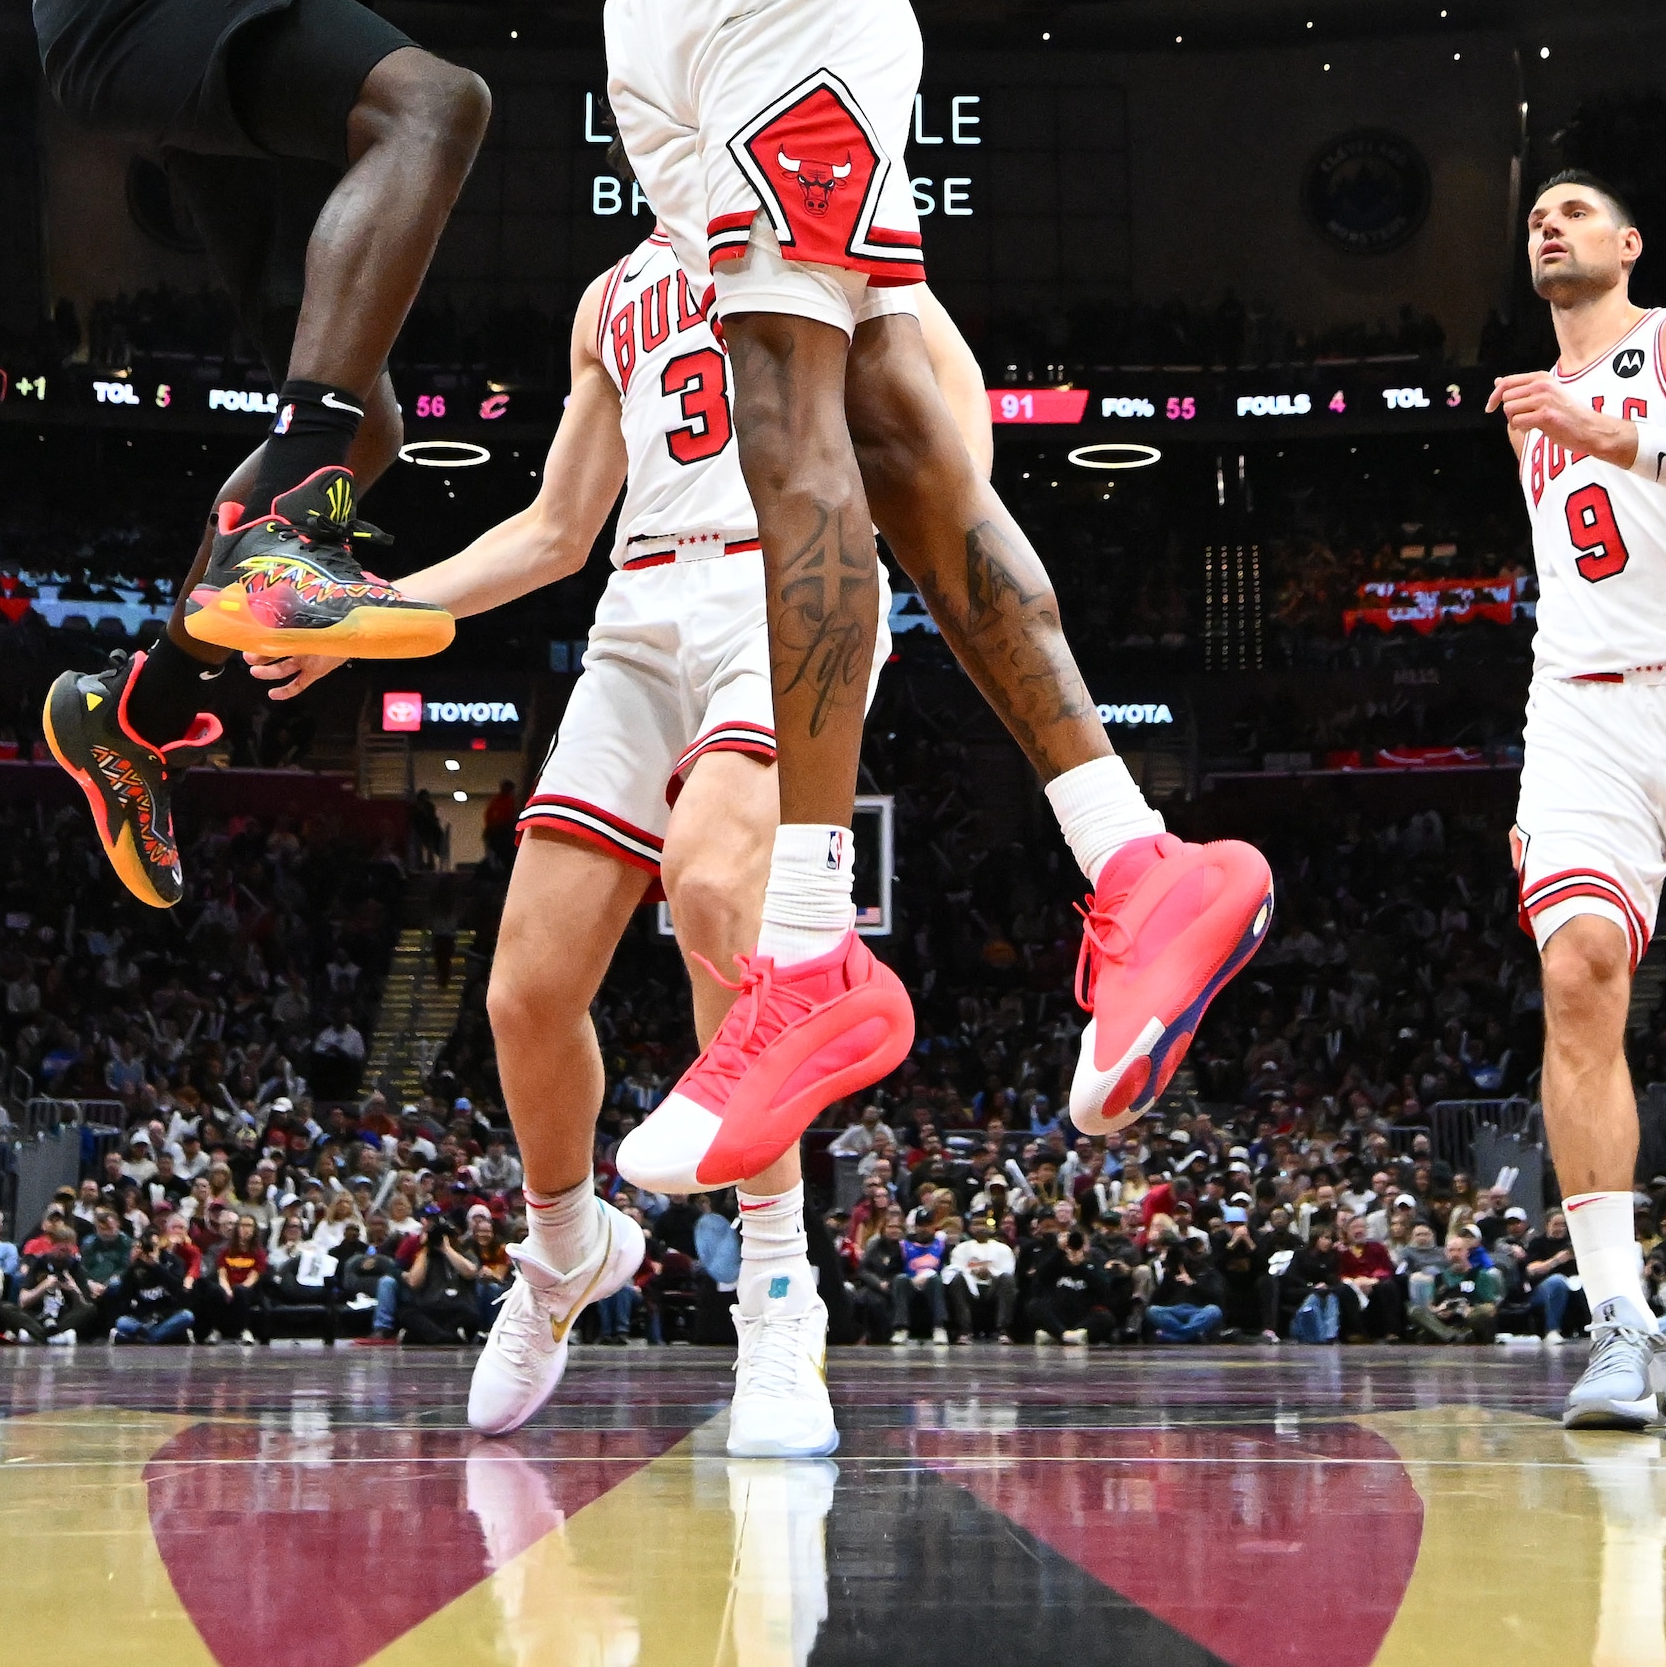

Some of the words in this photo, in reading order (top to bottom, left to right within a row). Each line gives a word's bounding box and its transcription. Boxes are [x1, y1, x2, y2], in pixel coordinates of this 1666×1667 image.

[15, 375, 47, 402] +1
[92, 380, 139, 405] TOL
[1382, 387, 1431, 410] TOL
[1446, 384, 1462, 408] 3
[415, 394, 447, 418] 56
[661, 347, 731, 467] 3
[1000, 393, 1035, 420] 91
[1101, 397, 1156, 419] FG%
[1165, 396, 1196, 421] 55
[1236, 393, 1312, 417] FOULS
[1328, 390, 1347, 414] 4
[1563, 481, 1630, 584] 9
[428, 702, 520, 724] TOYOTA
[1096, 703, 1174, 725] OYOTA
